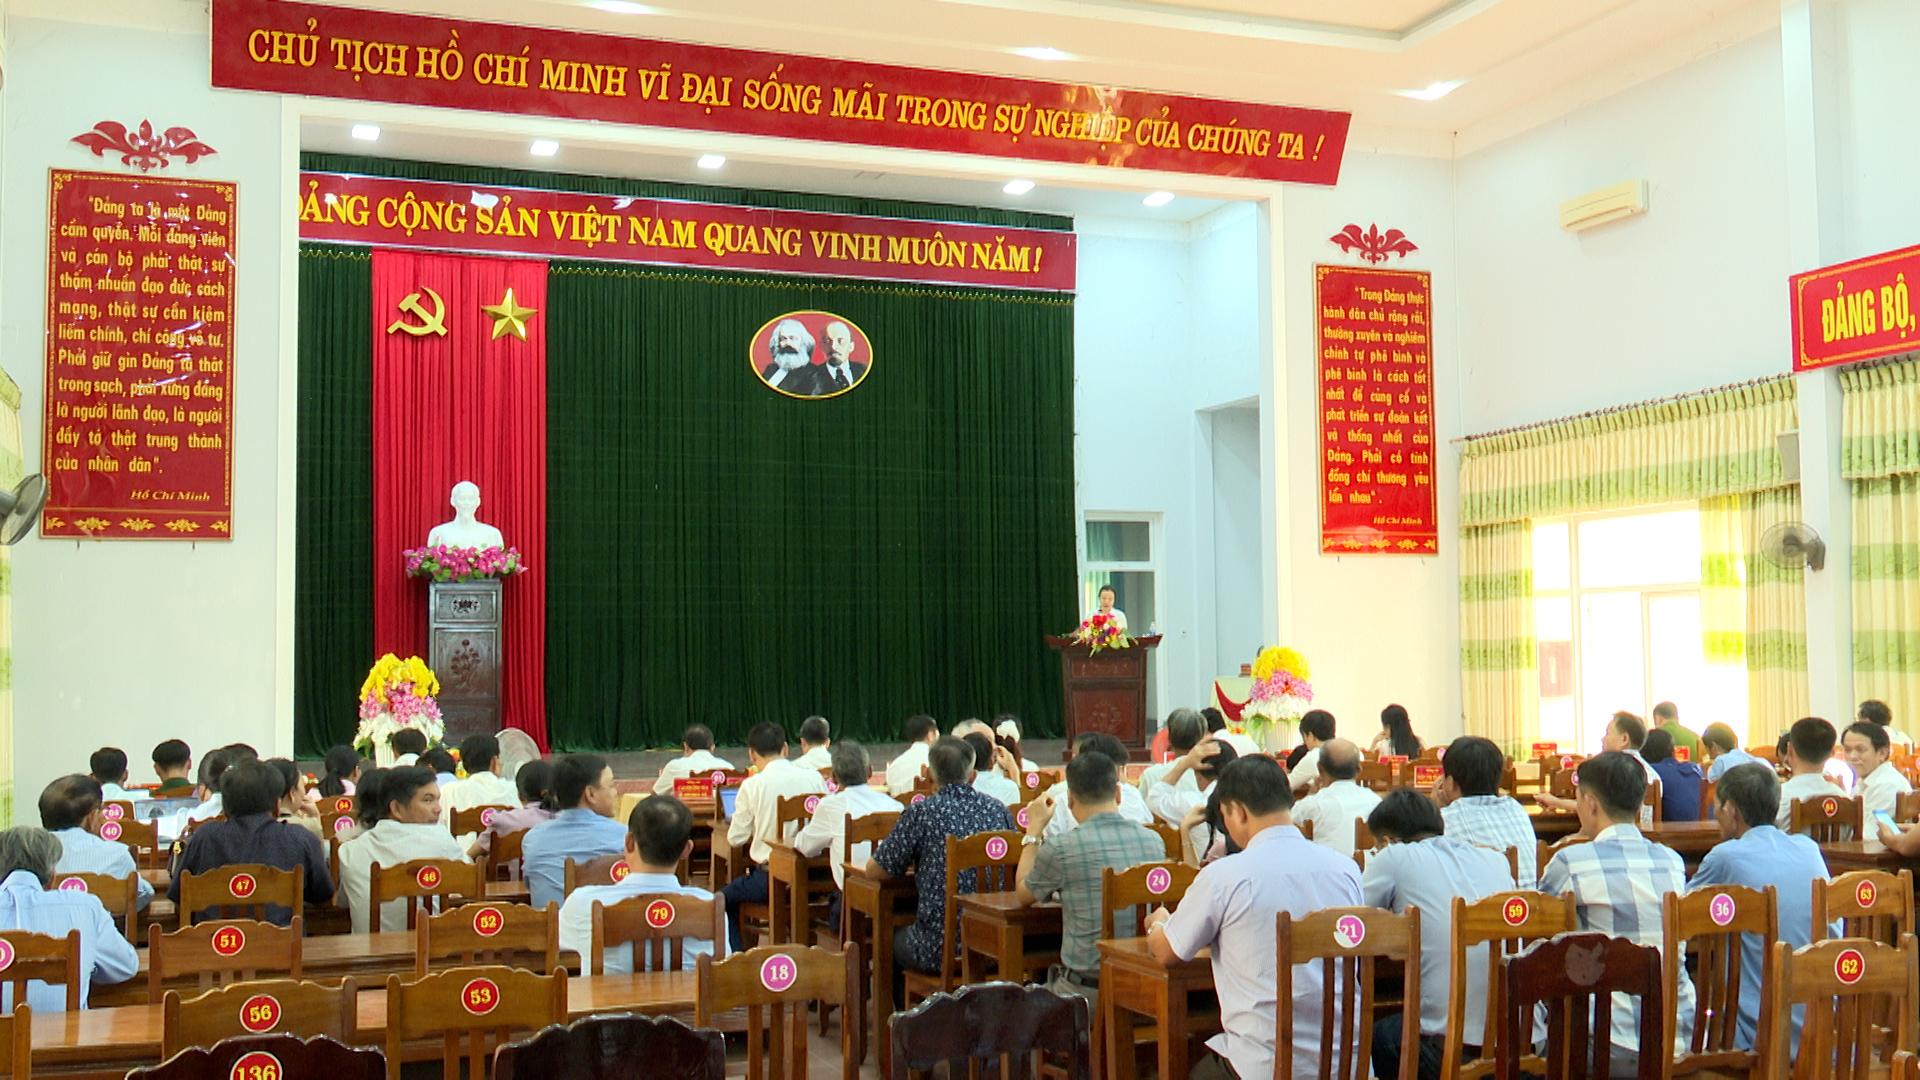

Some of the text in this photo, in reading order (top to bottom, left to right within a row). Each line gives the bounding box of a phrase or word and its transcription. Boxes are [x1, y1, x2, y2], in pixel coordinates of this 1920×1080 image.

[248, 17, 320, 68] CHỦ
[330, 38, 408, 82] TỊCH
[415, 29, 464, 80] HỒ
[473, 45, 530, 88] CHÍ
[539, 59, 628, 97] MINH
[638, 63, 672, 101] VĨ
[680, 72, 732, 114] ĐẠI
[743, 64, 822, 115] SỐNG
[830, 83, 885, 121] MÃI
[896, 95, 986, 130] TRONG
[993, 103, 1031, 143] SỰ
[1032, 105, 1131, 150] NGHIỆP
[1135, 106, 1181, 149] CỦA
[1187, 119, 1271, 157] CHÚNG
[1278, 133, 1304, 160] TA
[132, 202, 143, 216] ta
[197, 204, 226, 225] Đảng
[167, 225, 196, 248] đảng
[377, 192, 467, 237] CỘNG
[476, 195, 539, 238] SẢN
[546, 205, 622, 248] VIỆT
[628, 217, 698, 248] NAM
[704, 222, 802, 256] QUANG
[809, 230, 882, 263] VINH
[887, 232, 967, 266] MUÔN
[61, 243, 225, 276] và cán bộ phải thật sự
[142, 278, 164, 298] đạo
[197, 280, 224, 296] cách
[1384, 288, 1405, 306] Đảng
[108, 301, 136, 322] thật
[143, 300, 158, 323] sự
[193, 306, 224, 326] kiệm
[1822, 273, 1915, 343] ĐẢNG BỘ,
[1349, 308, 1366, 320] dân
[1369, 308, 1384, 321] chủ
[1389, 310, 1408, 326] rộng
[90, 328, 127, 343] chính,
[133, 328, 150, 343] chí
[1356, 329, 1380, 343] xuyên
[1383, 329, 1393, 342] và
[58, 348, 86, 366] Phải
[92, 352, 111, 370] giữ
[118, 355, 137, 371] gìn
[142, 352, 174, 374] Đảng
[199, 356, 223, 377] thật
[1355, 350, 1364, 364] tự
[1370, 350, 1387, 364] phê
[1416, 351, 1425, 364] và
[1325, 366, 1341, 381] phê
[1373, 368, 1382, 382] là
[1388, 370, 1409, 382] cách
[1414, 369, 1426, 384] tốt
[58, 377, 91, 396] trong
[94, 378, 126, 397] sạch,
[1370, 387, 1392, 406] củng
[1399, 388, 1410, 403] cố
[1416, 391, 1427, 404] và
[57, 402, 222, 425] là người lãnh đạo, là người
[1374, 411, 1384, 426] sự
[1414, 410, 1428, 424] kết
[112, 429, 136, 450] thật
[147, 434, 178, 451] trung
[188, 433, 222, 448] thành
[1327, 428, 1337, 441] và
[1348, 428, 1372, 446] thống
[1413, 430, 1428, 444] của
[55, 451, 78, 470] của
[88, 456, 119, 471] nhân
[1362, 448, 1382, 463] Phải
[1391, 450, 1402, 463] có
[1377, 471, 1406, 487] thương
[153, 490, 174, 501] Chí
[178, 491, 210, 501] Minh
[991, 842, 1003, 853] 12
[422, 872, 436, 882] 46
[616, 867, 629, 877] 45
[1152, 874, 1165, 886] 24
[236, 880, 249, 891] 47
[653, 908, 668, 920] 79
[1509, 905, 1523, 918] 59
[1716, 903, 1730, 916] 36
[480, 915, 496, 928] 52
[220, 934, 237, 947] 51
[769, 965, 789, 981] 18
[1841, 960, 1858, 974] 62
[470, 988, 491, 1005] 53
[250, 1005, 272, 1022] 56
[237, 1065, 276, 1080] 136
